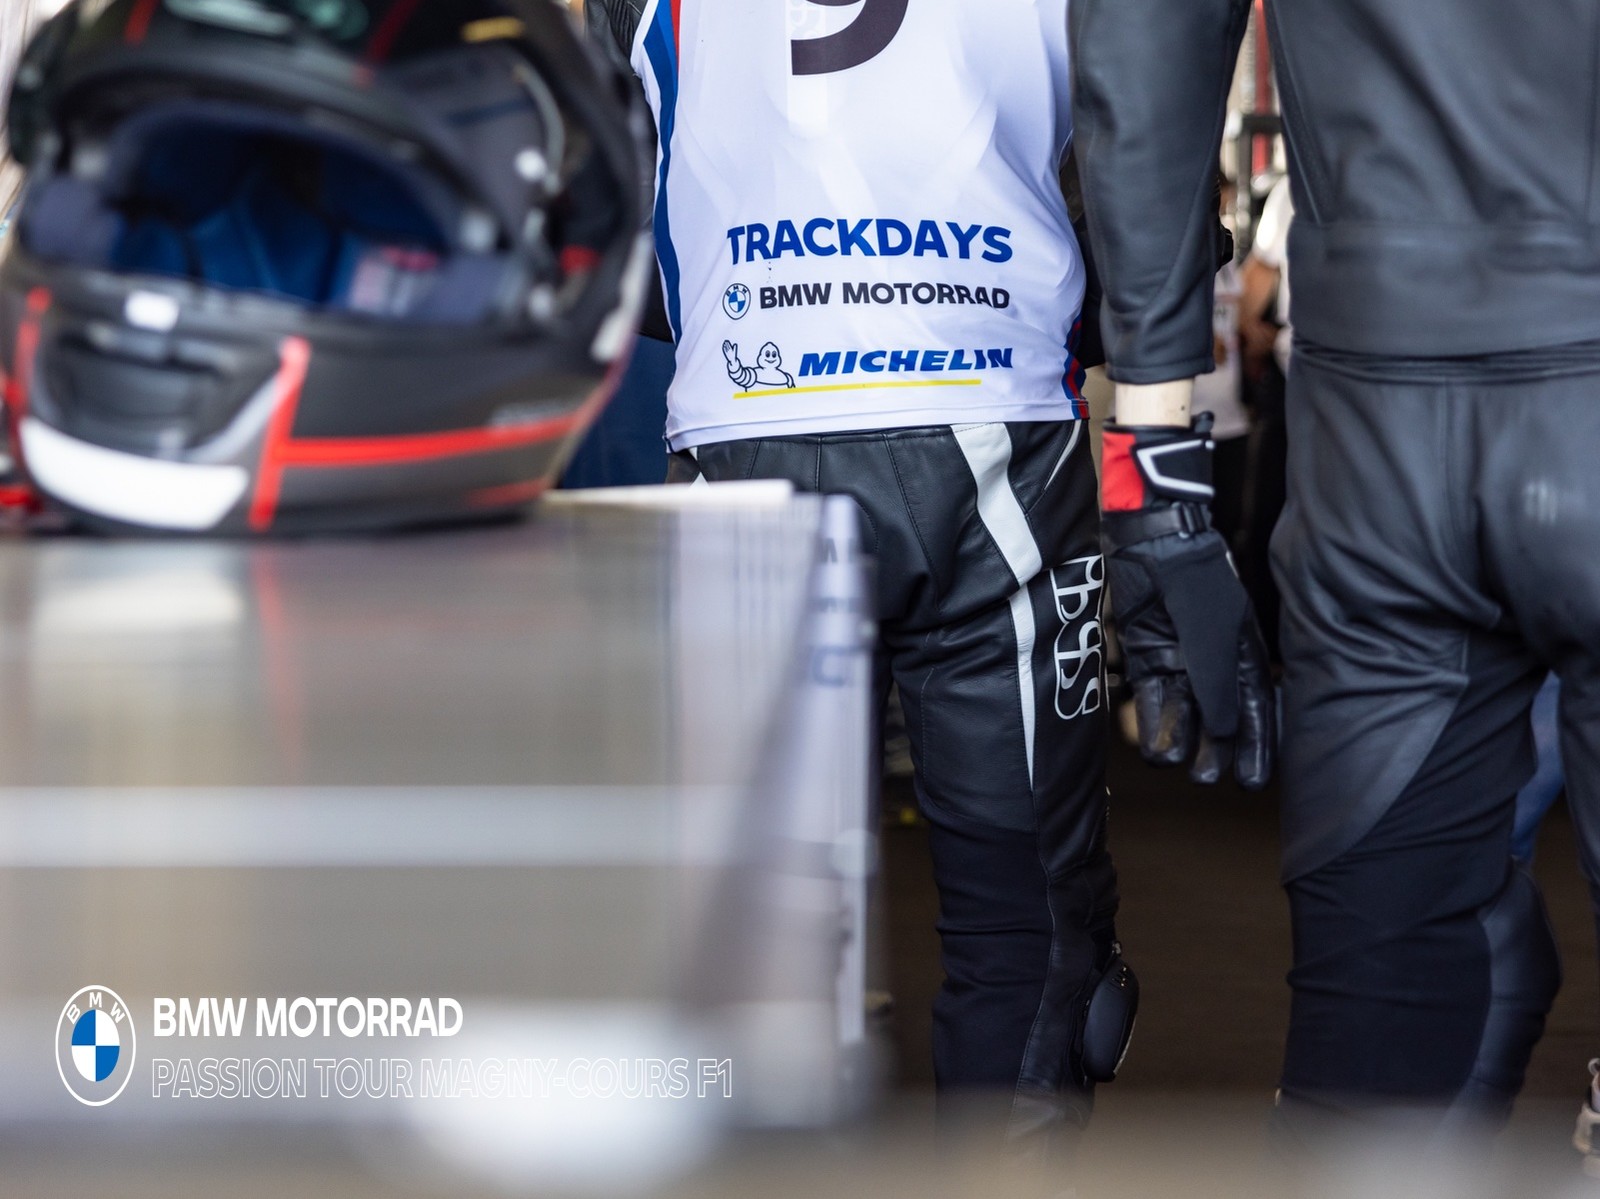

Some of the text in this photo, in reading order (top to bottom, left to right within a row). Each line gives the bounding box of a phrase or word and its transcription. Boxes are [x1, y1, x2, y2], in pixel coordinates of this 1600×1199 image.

[727, 217, 1013, 265] TRACKDAYS
[760, 282, 1010, 309] BMW MOTORRAD
[798, 348, 1013, 377] MICHELIN
